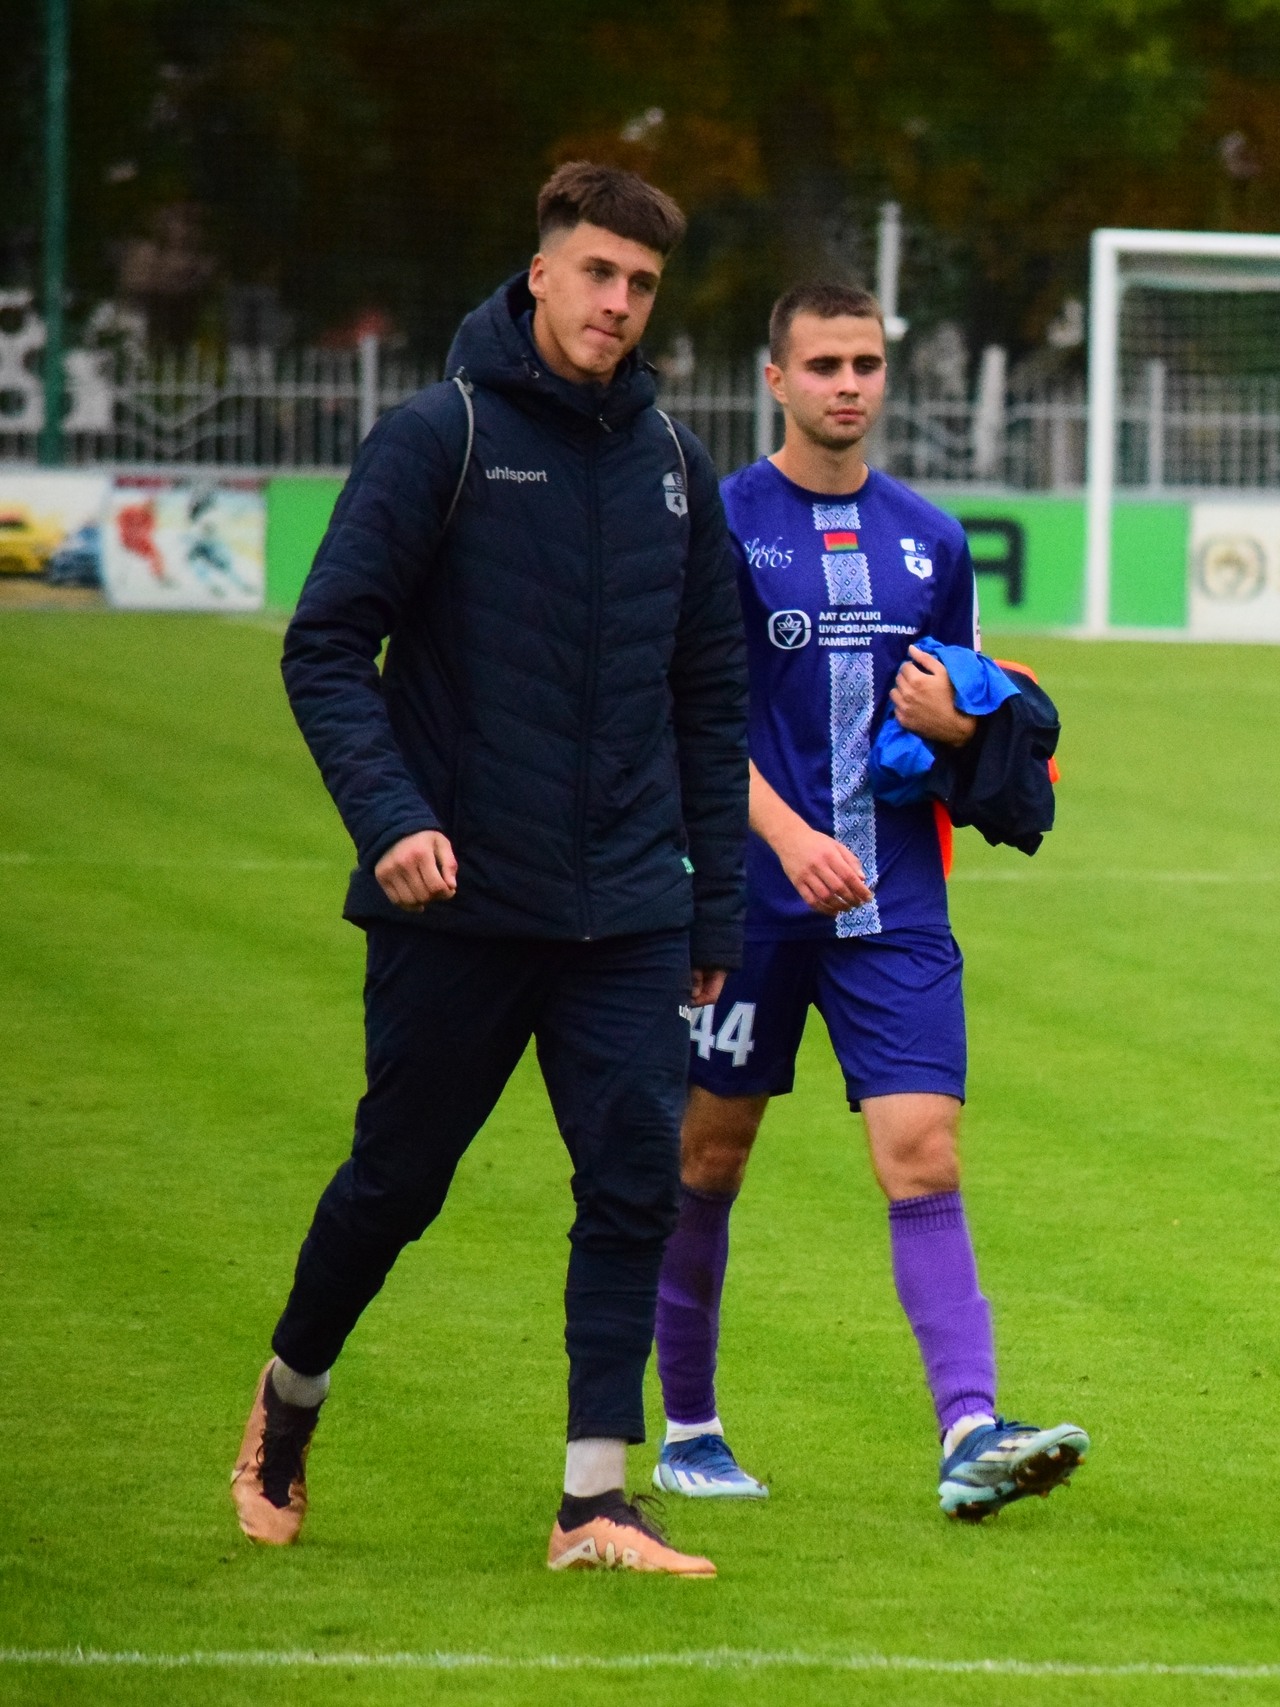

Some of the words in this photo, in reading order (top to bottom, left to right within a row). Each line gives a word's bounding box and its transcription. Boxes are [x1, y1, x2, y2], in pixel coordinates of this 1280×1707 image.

[485, 466, 548, 484] uhlsport
[818, 611, 838, 621] ААТ
[840, 610, 881, 621] СЛУЦКІ
[818, 636, 873, 647] КАМБІНАТ
[690, 1001, 756, 1067] 44
